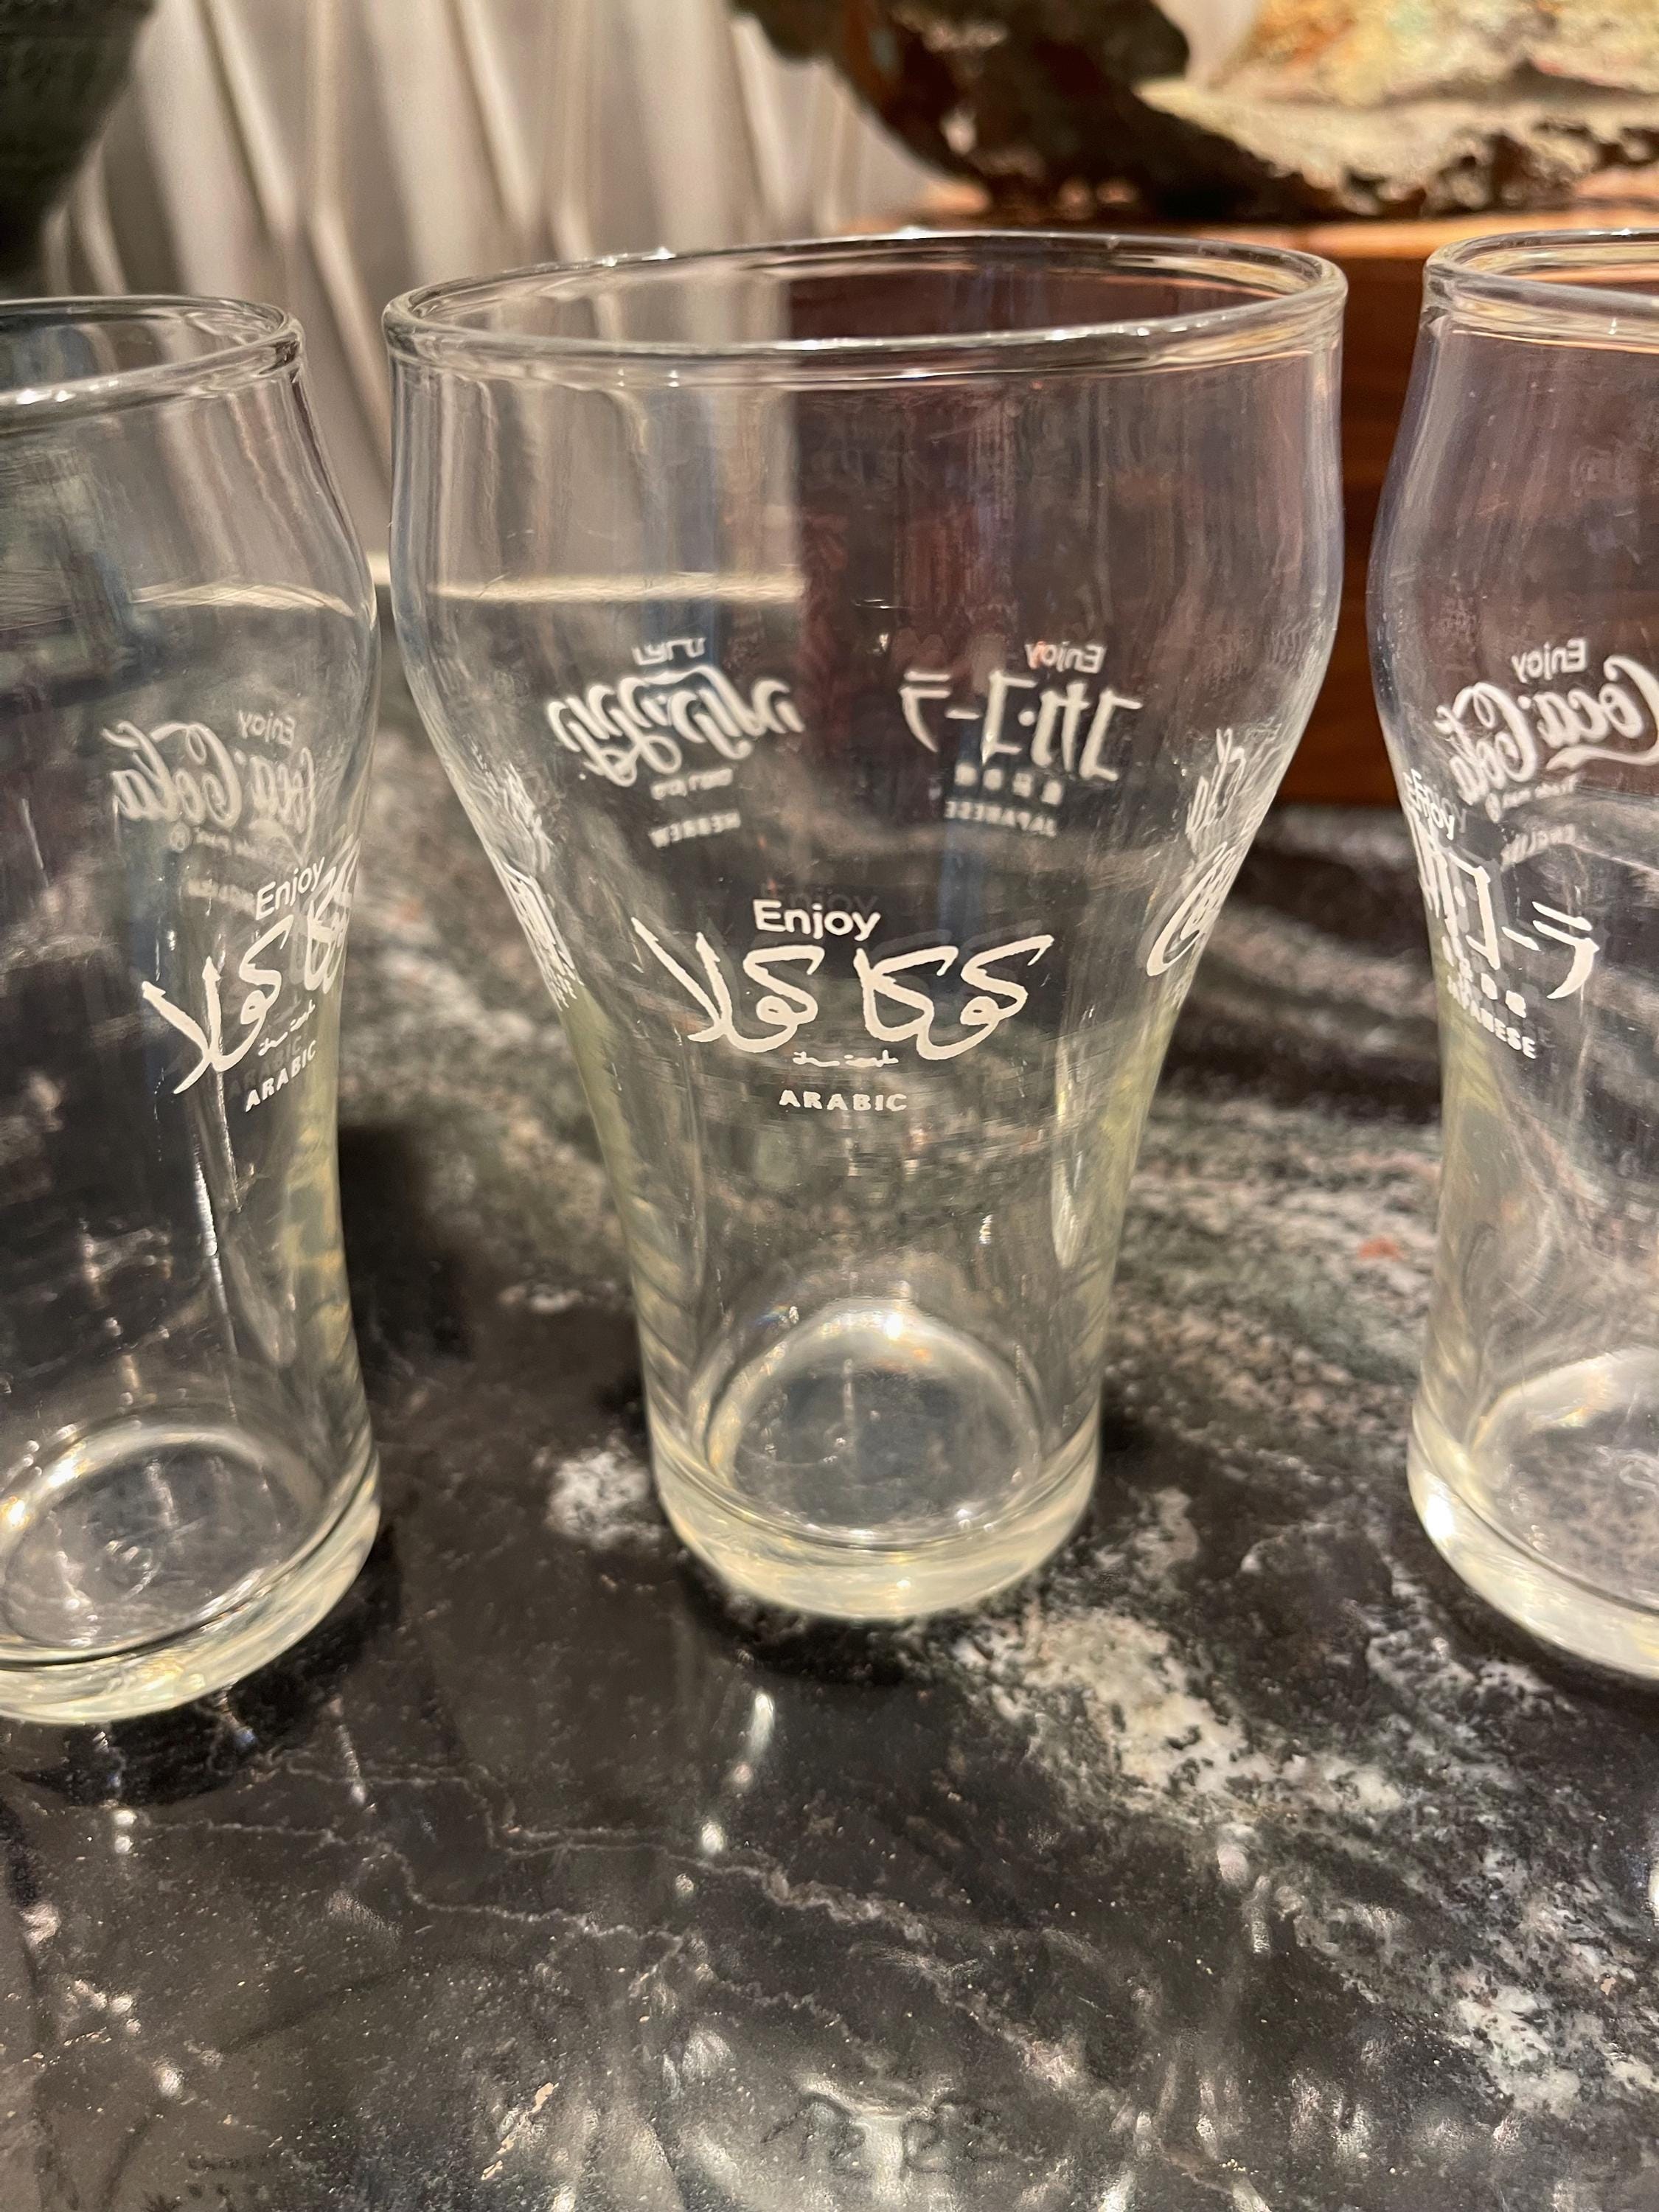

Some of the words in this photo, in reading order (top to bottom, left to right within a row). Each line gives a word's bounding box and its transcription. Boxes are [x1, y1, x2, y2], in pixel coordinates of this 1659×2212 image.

[256, 856, 325, 921] Enjoy
[753, 898, 881, 941] Enjoy
[244, 1039, 317, 1113] ARABIC
[779, 1089, 908, 1112] ARABIC
